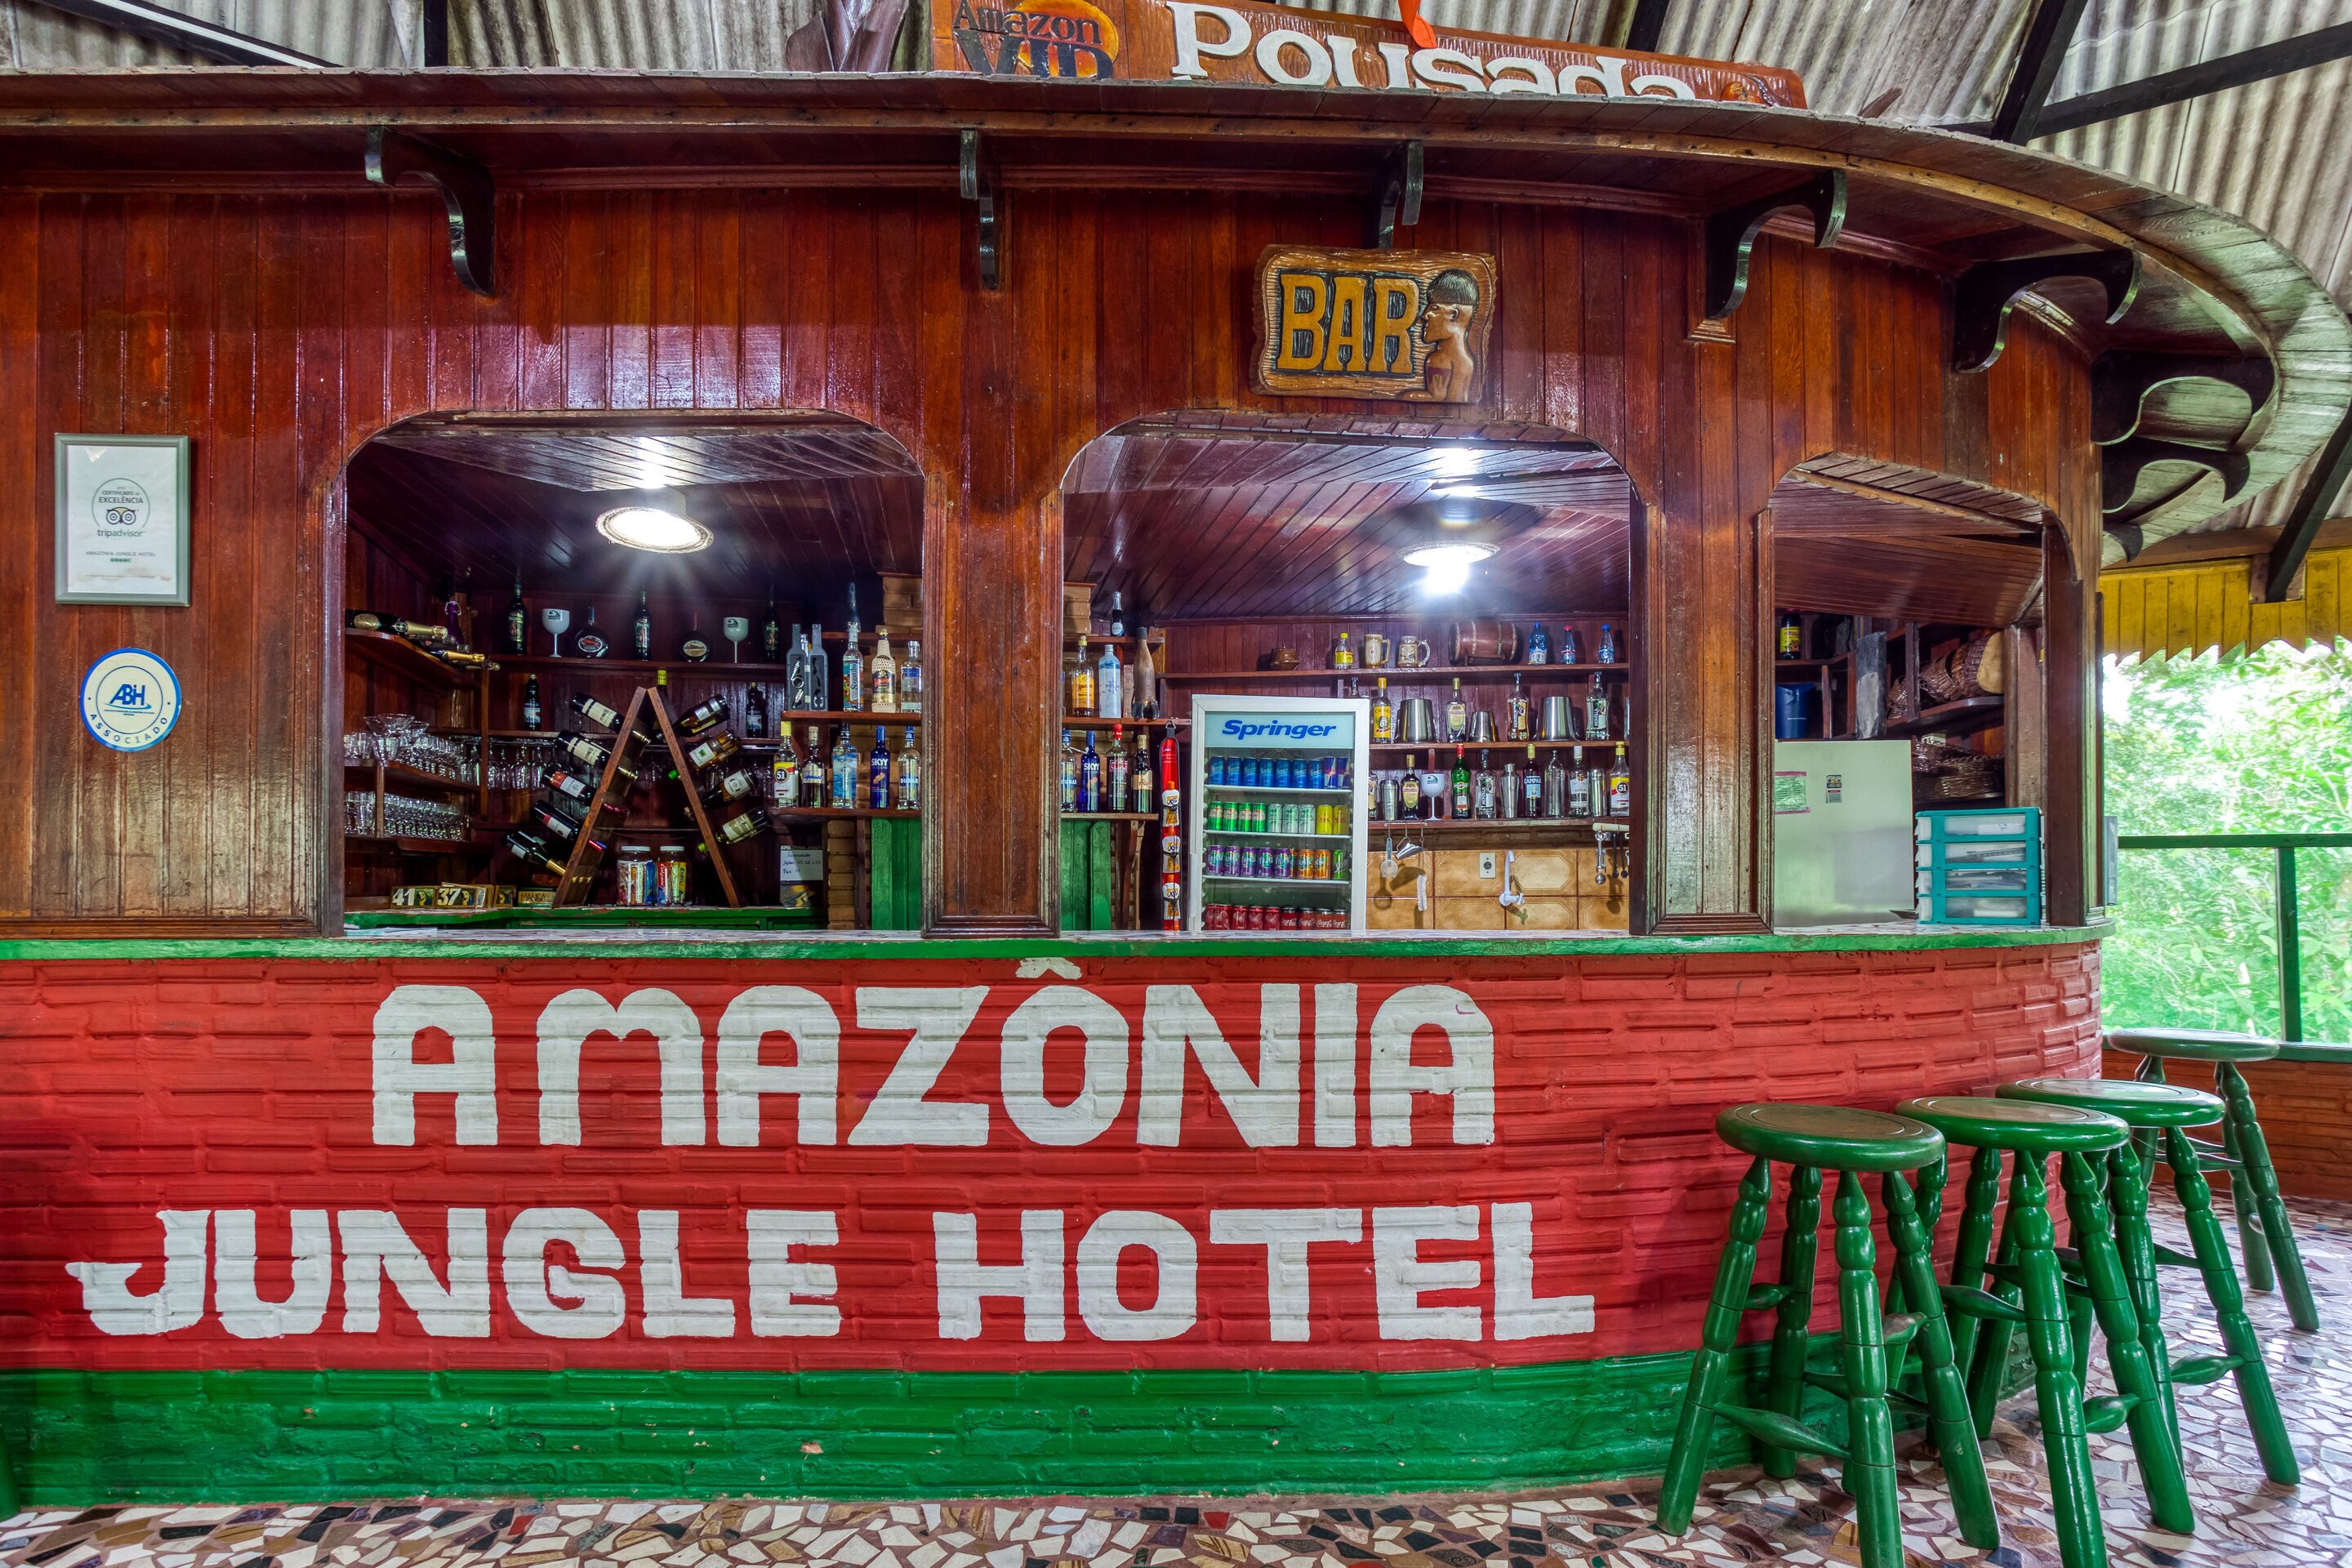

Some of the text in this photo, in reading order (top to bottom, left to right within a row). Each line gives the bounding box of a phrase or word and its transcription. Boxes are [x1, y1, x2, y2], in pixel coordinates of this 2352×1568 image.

[1276, 274, 1419, 374] BAR
[90, 714, 167, 744] ASSOCIADO
[1222, 719, 1337, 740] Springer
[871, 758, 889, 766] SKYY
[776, 770, 786, 780] 51
[392, 888, 416, 906] 41
[437, 888, 461, 906] 37
[370, 957, 1496, 1147] AMAZÔNIA
[65, 1201, 1596, 1343] JUNGLE HOTEL
